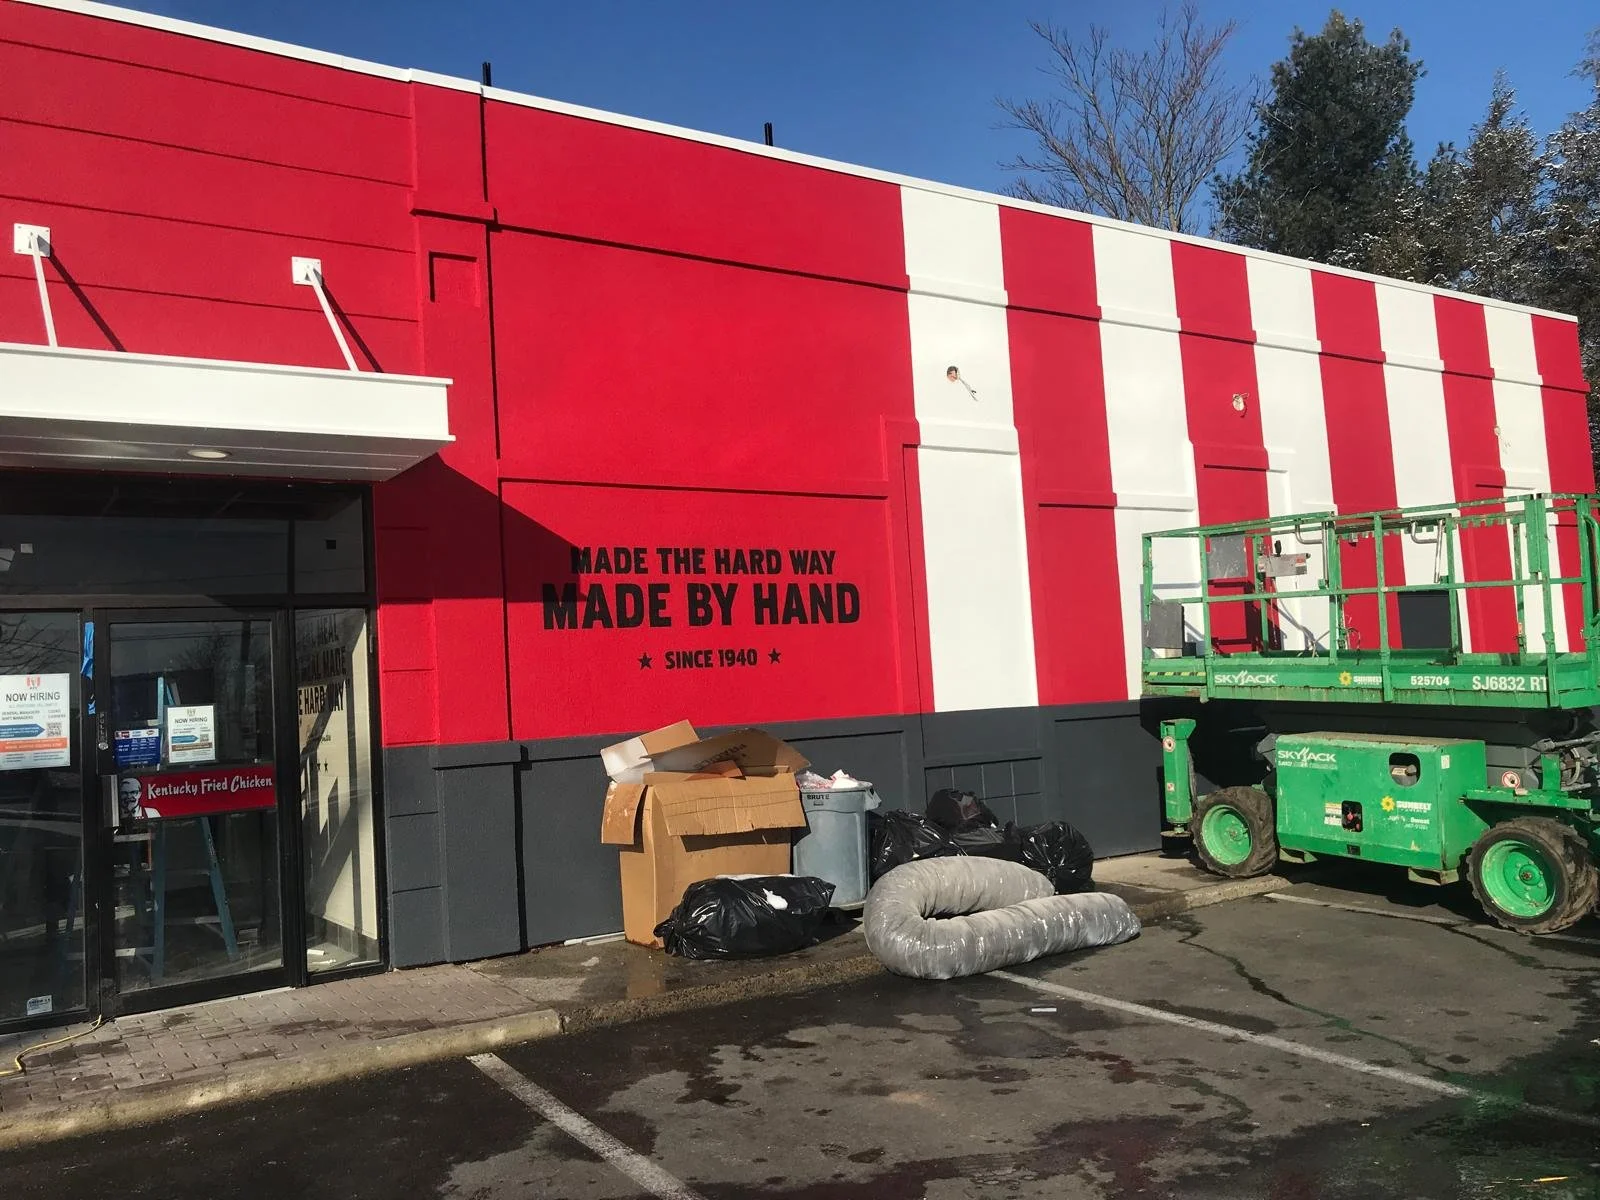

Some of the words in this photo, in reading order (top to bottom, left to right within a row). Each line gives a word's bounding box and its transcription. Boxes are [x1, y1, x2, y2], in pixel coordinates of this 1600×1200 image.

[572, 547, 648, 575] MADE
[656, 548, 705, 574] THE
[714, 549, 782, 575] HARD
[790, 550, 836, 575] WAY
[542, 583, 672, 630] MADE
[687, 583, 738, 627] BY
[754, 582, 861, 625] HAND
[665, 649, 713, 670] SINCE
[718, 648, 758, 667] 1940
[1214, 670, 1276, 685] SKYJACK
[1411, 676, 1450, 686] 525704
[1472, 675, 1526, 691] SJ6832
[6, 693, 28, 702] NOW
[30, 692, 61, 701] HIRING
[304, 687, 326, 714] HARD
[190, 716, 208, 724] HIRING
[1278, 746, 1337, 764] SKYJACK
[147, 781, 198, 800] Kentucky
[201, 777, 228, 795] Fried
[230, 775, 273, 793] Chicken
